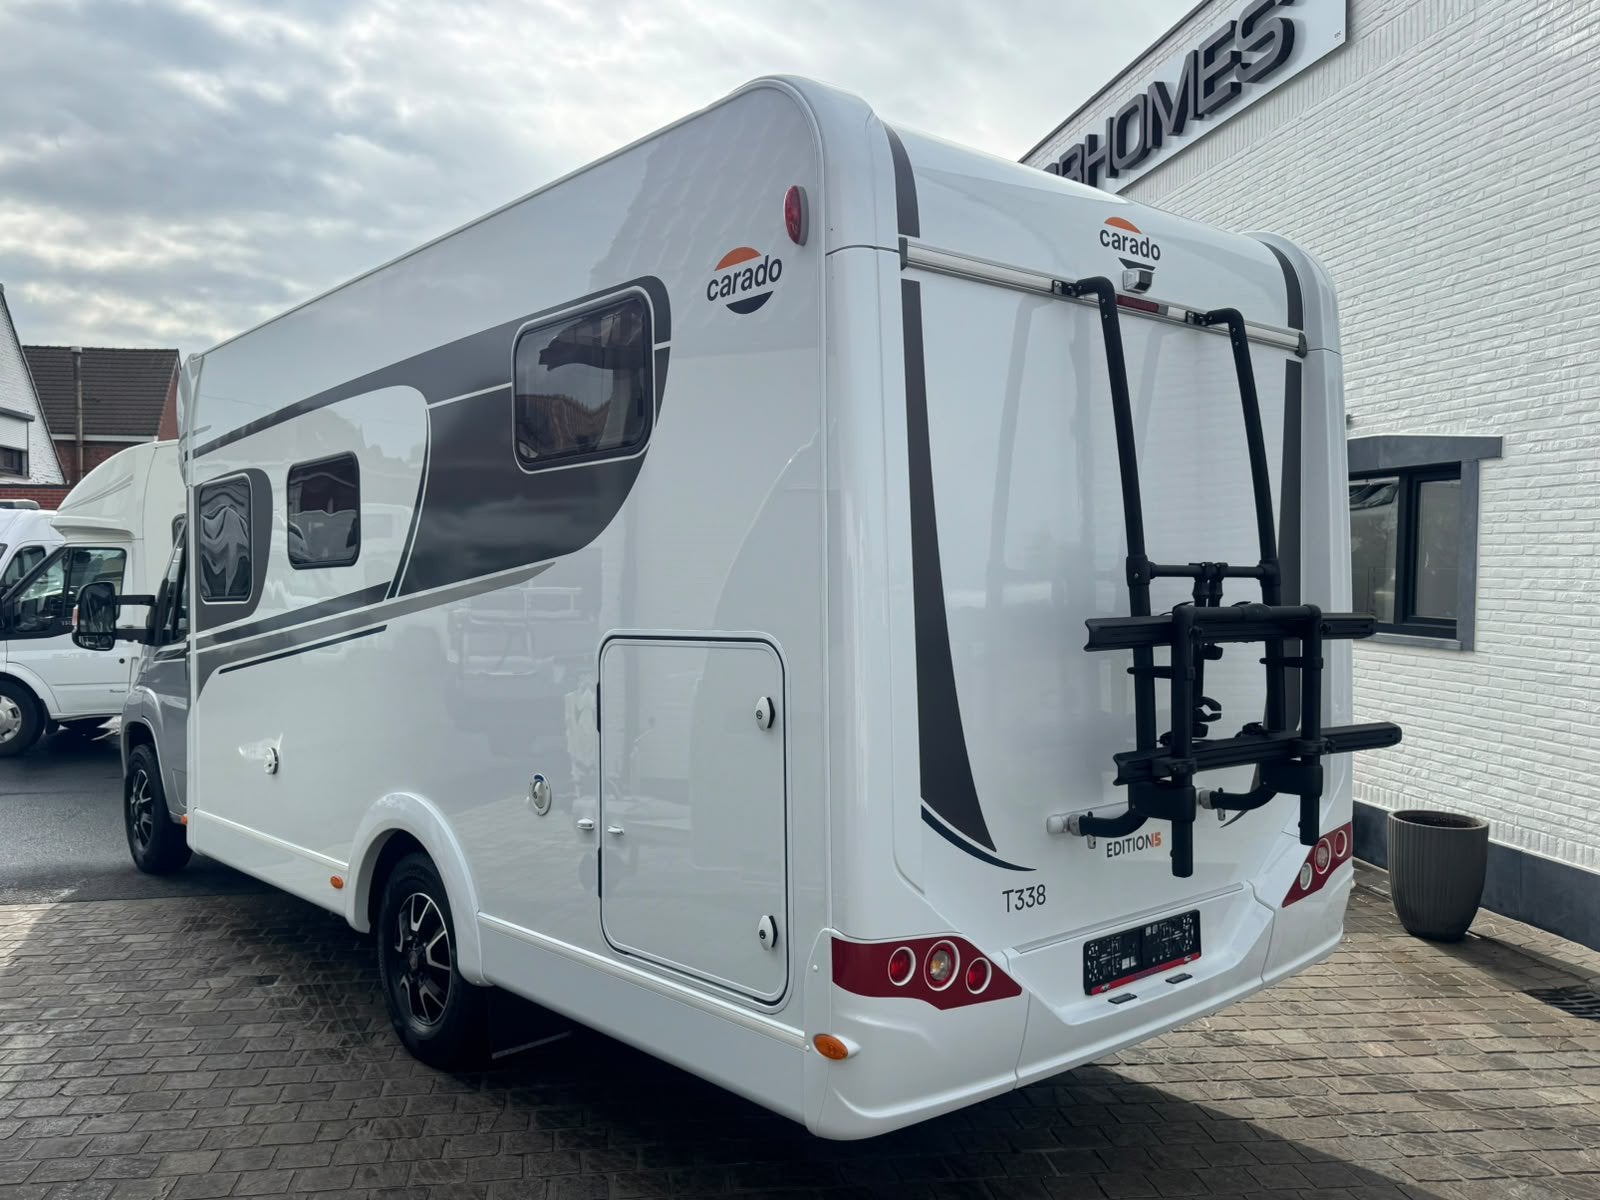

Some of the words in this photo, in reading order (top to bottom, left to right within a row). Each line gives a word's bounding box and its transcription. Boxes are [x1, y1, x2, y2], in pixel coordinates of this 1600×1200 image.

[1042, 0, 1295, 188] RHOMES
[1100, 229, 1161, 261] carado
[706, 254, 783, 302] carado
[1002, 884, 1046, 912] T338
